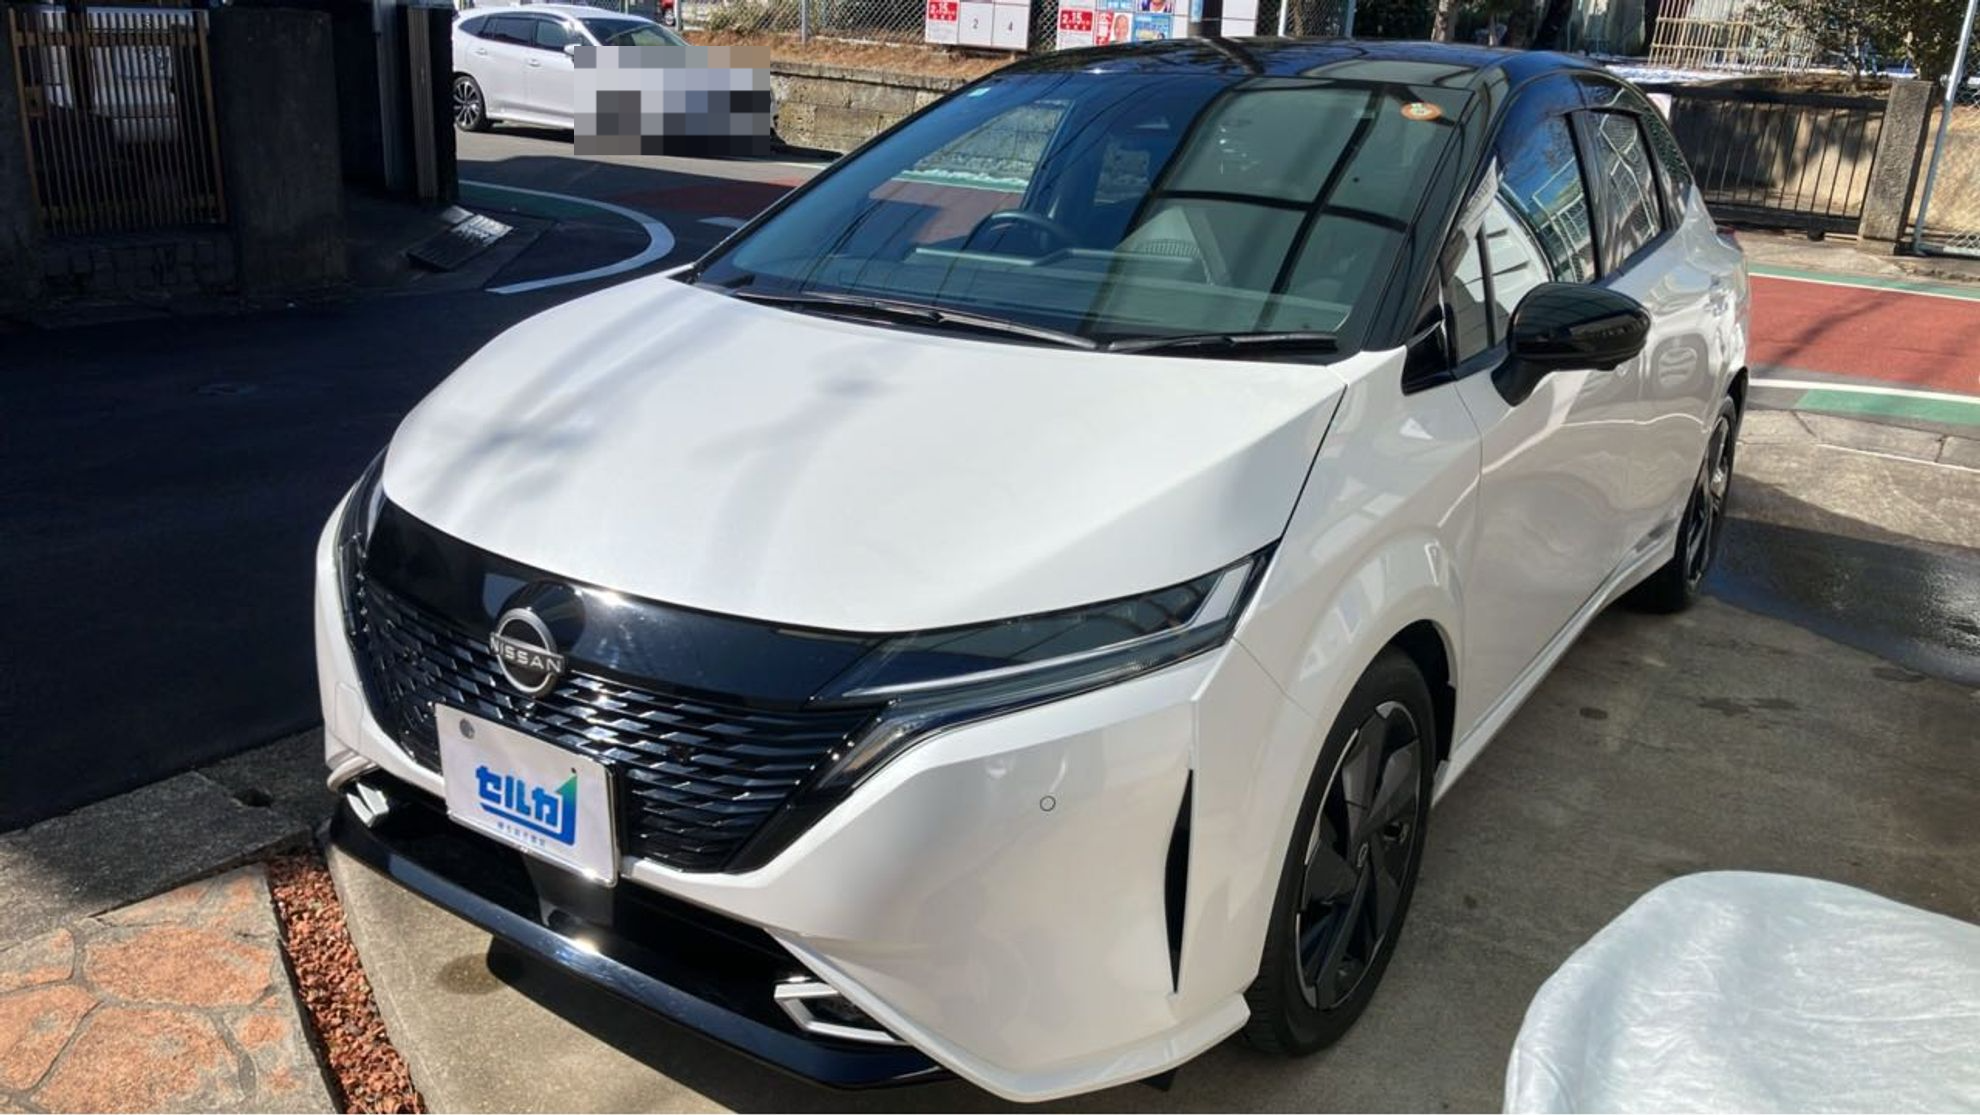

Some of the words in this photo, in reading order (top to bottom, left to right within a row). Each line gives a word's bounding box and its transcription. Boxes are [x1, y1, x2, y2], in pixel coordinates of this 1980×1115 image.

[971, 17, 979, 30] 2
[1007, 20, 1014, 32] 4
[490, 634, 561, 673] NISSAN
[476, 765, 559, 828] セルカ
